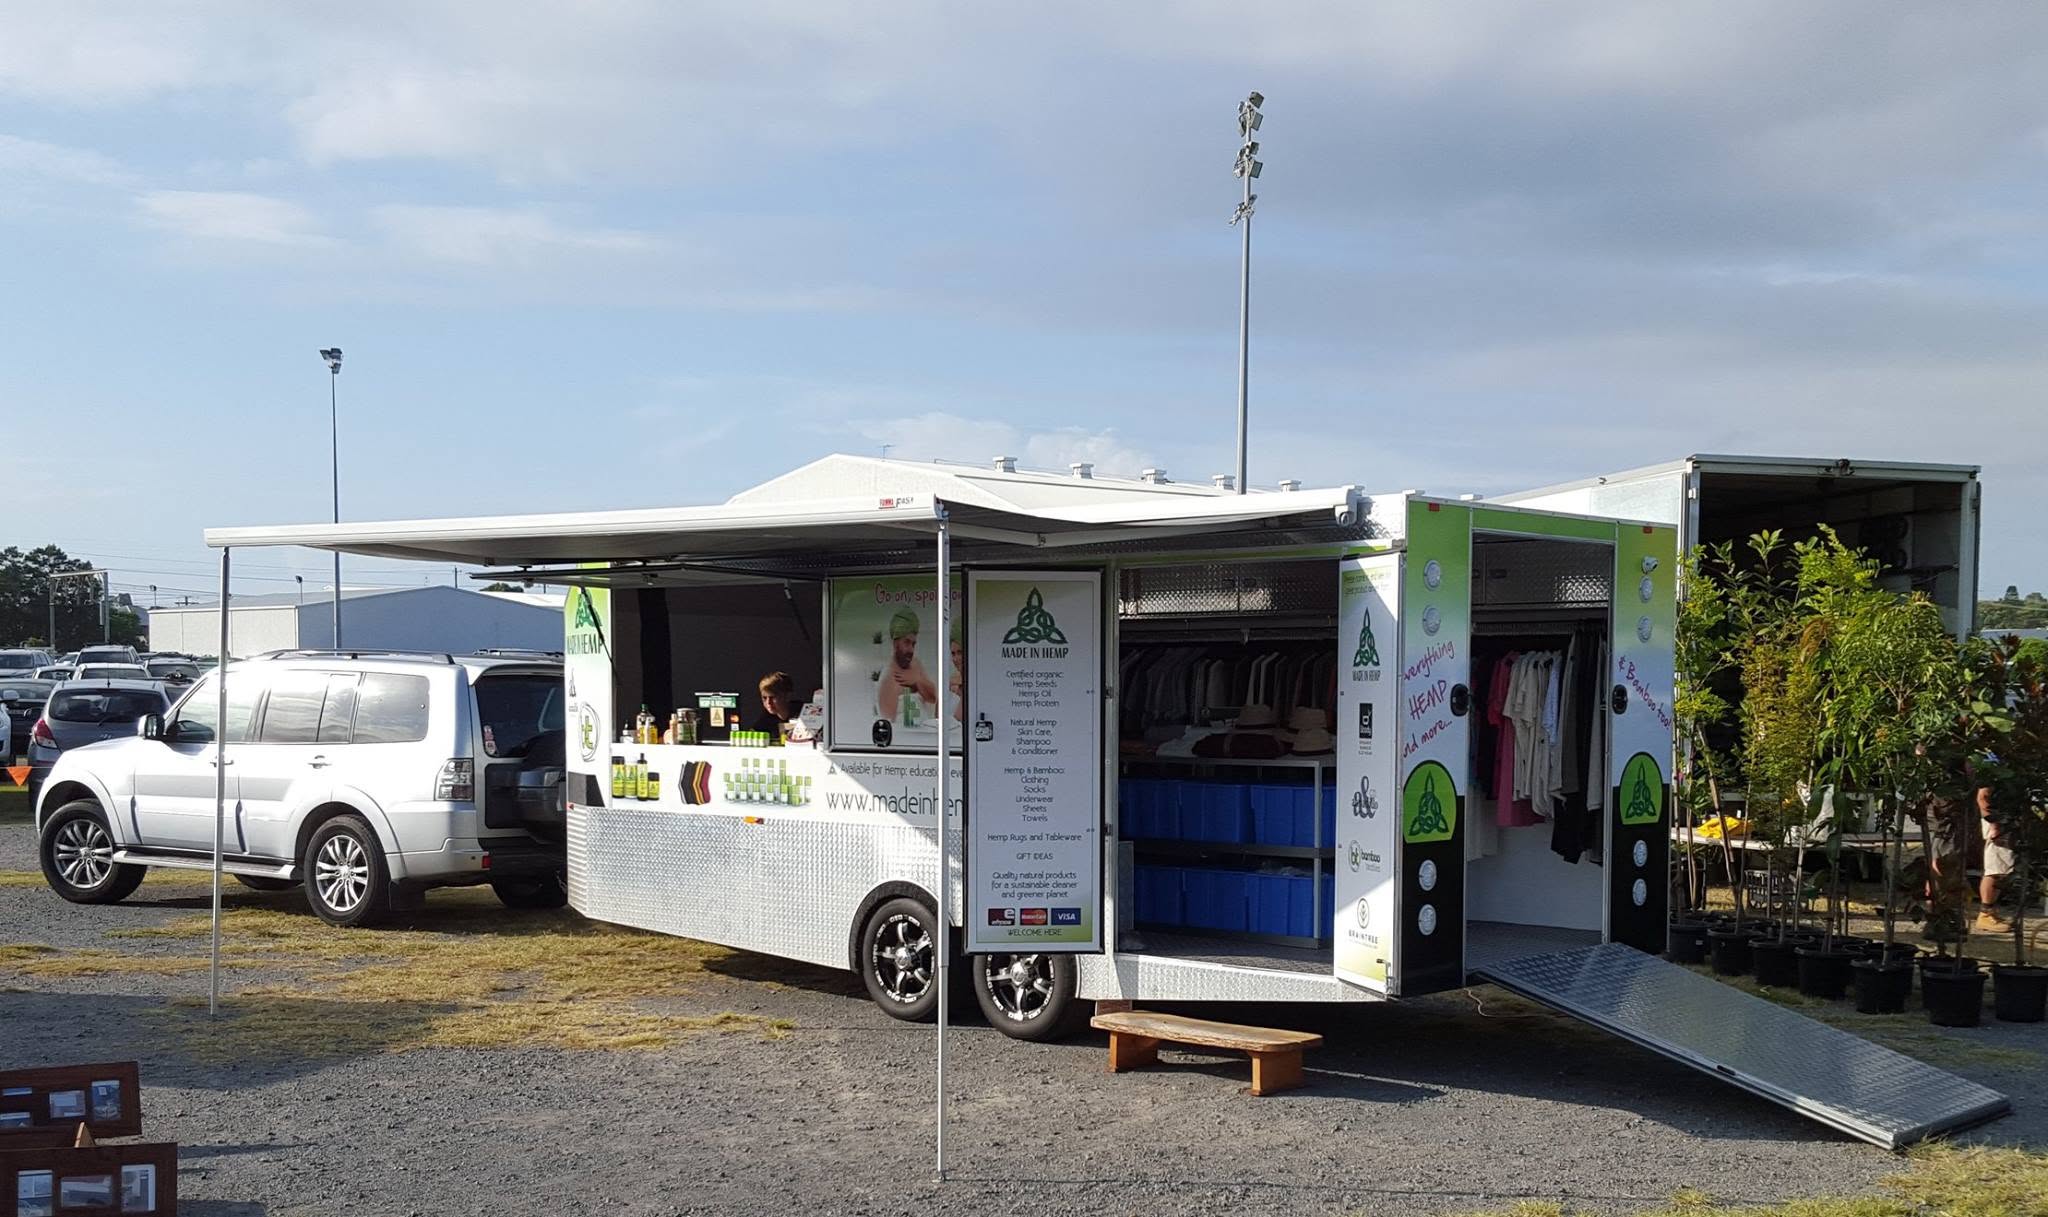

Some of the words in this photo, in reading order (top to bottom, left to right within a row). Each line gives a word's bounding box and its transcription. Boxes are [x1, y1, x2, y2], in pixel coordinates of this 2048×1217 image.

[875, 582, 891, 604] Go
[1002, 647, 1028, 659] MADE
[1030, 647, 1040, 659] IN
[1042, 647, 1069, 659] HEMP
[1403, 641, 1454, 680] verything
[1006, 669, 1034, 680] Certified
[1012, 680, 1033, 688] Hemp
[1018, 690, 1040, 698] Hemp
[1626, 661, 1656, 711] Bamboo
[1657, 702, 1672, 730] too!
[1011, 700, 1032, 708] Hemp
[1034, 699, 1060, 707] Protein
[1408, 680, 1447, 720] HEMP
[1010, 718, 1035, 726] Natural
[1037, 719, 1057, 728] Hemp
[1017, 728, 1032, 736] Skin
[1015, 737, 1051, 748] Shampoo
[1018, 747, 1058, 755] Conditioner
[841, 762, 871, 775] Available
[872, 762, 883, 778] for
[909, 764, 939, 777] educati
[1004, 767, 1024, 776] Hemp
[1021, 775, 1049, 785] Clothing
[1023, 785, 1046, 793] Socks
[1015, 794, 1053, 803] Underwear
[1022, 804, 1047, 812] Sheets
[1022, 814, 1048, 822] Towels
[987, 833, 1008, 842] Hemp
[1010, 833, 1027, 843] Rugs
[1029, 833, 1043, 841] and
[1045, 832, 1082, 841] Tableware
[1033, 852, 1053, 860] IDEAS
[992, 871, 1017, 881] Quality
[1020, 871, 1044, 879] natural
[1046, 871, 1076, 881] products
[991, 880, 1002, 889] for
[1011, 880, 1050, 888] sustainable
[1001, 890, 1015, 898] and
[1017, 891, 1044, 900] greener
[1046, 890, 1068, 900] planet
[1007, 928, 1042, 936] WELCOME
[1044, 928, 1063, 936] HERE
